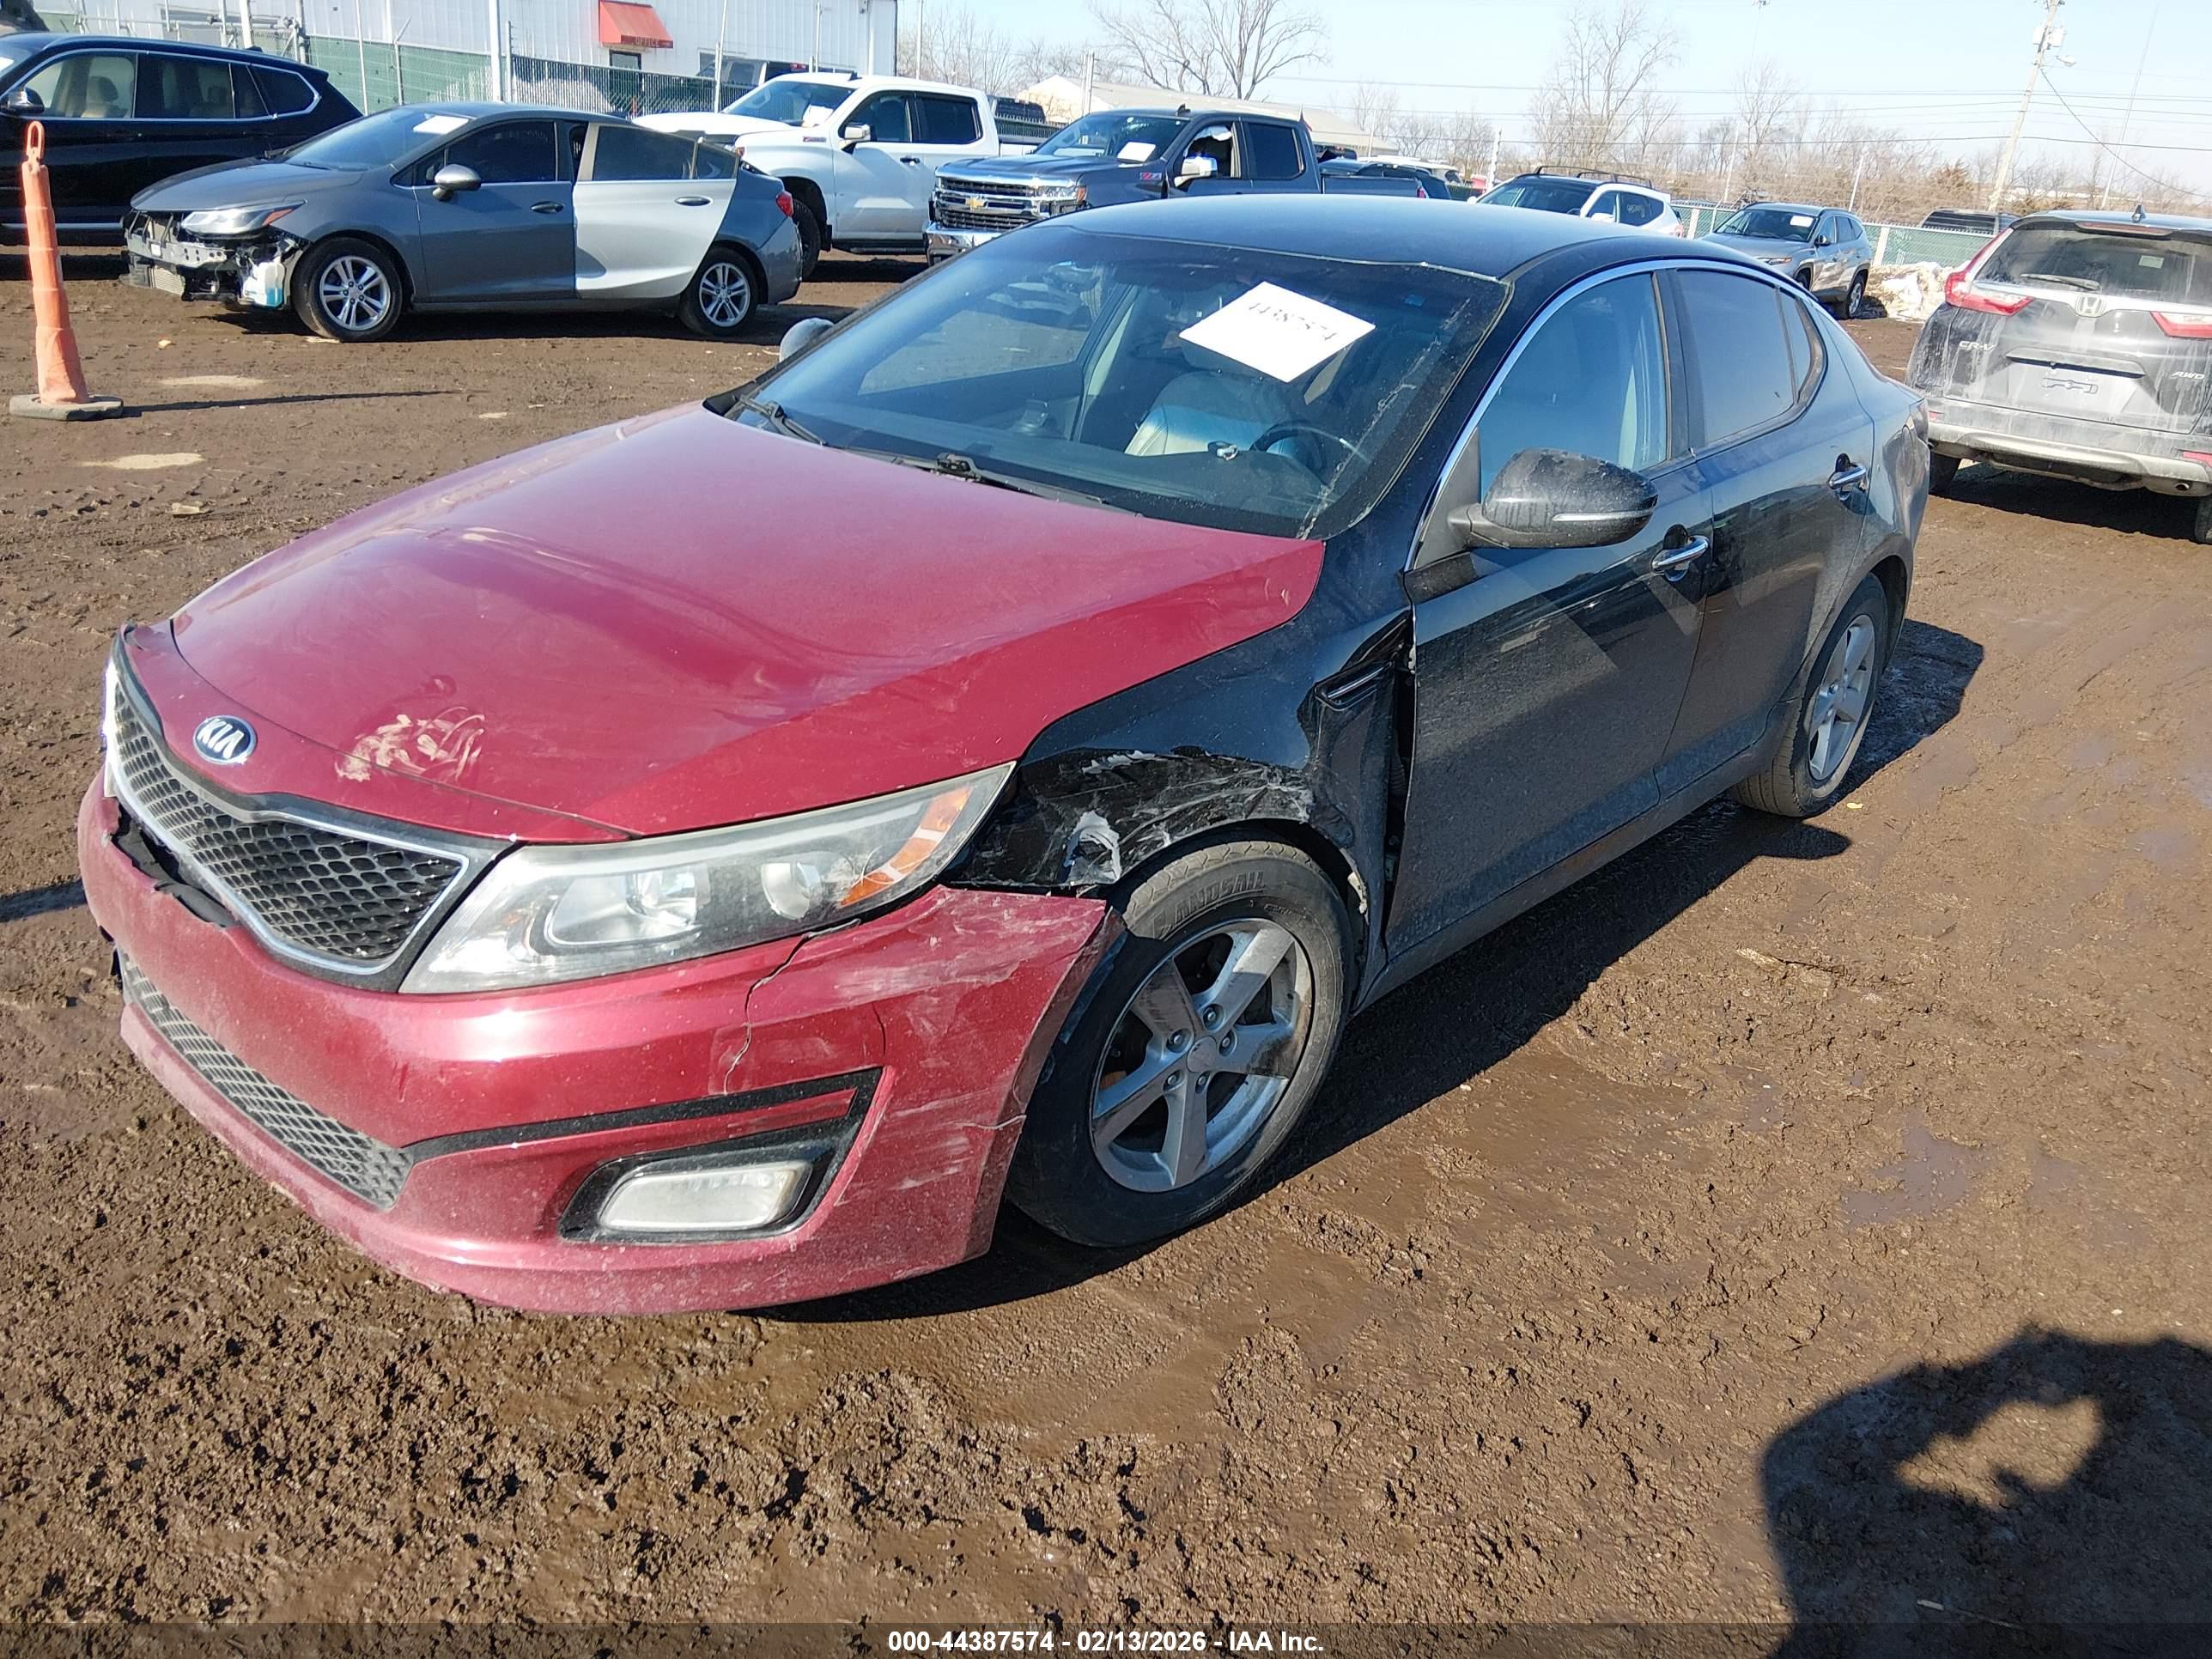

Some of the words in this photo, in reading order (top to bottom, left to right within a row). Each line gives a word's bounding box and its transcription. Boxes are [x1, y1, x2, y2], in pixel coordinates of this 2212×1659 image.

[1959, 340, 1997, 351] CR-V
[2171, 371, 2206, 380] AWD
[197, 718, 245, 759] KIA
